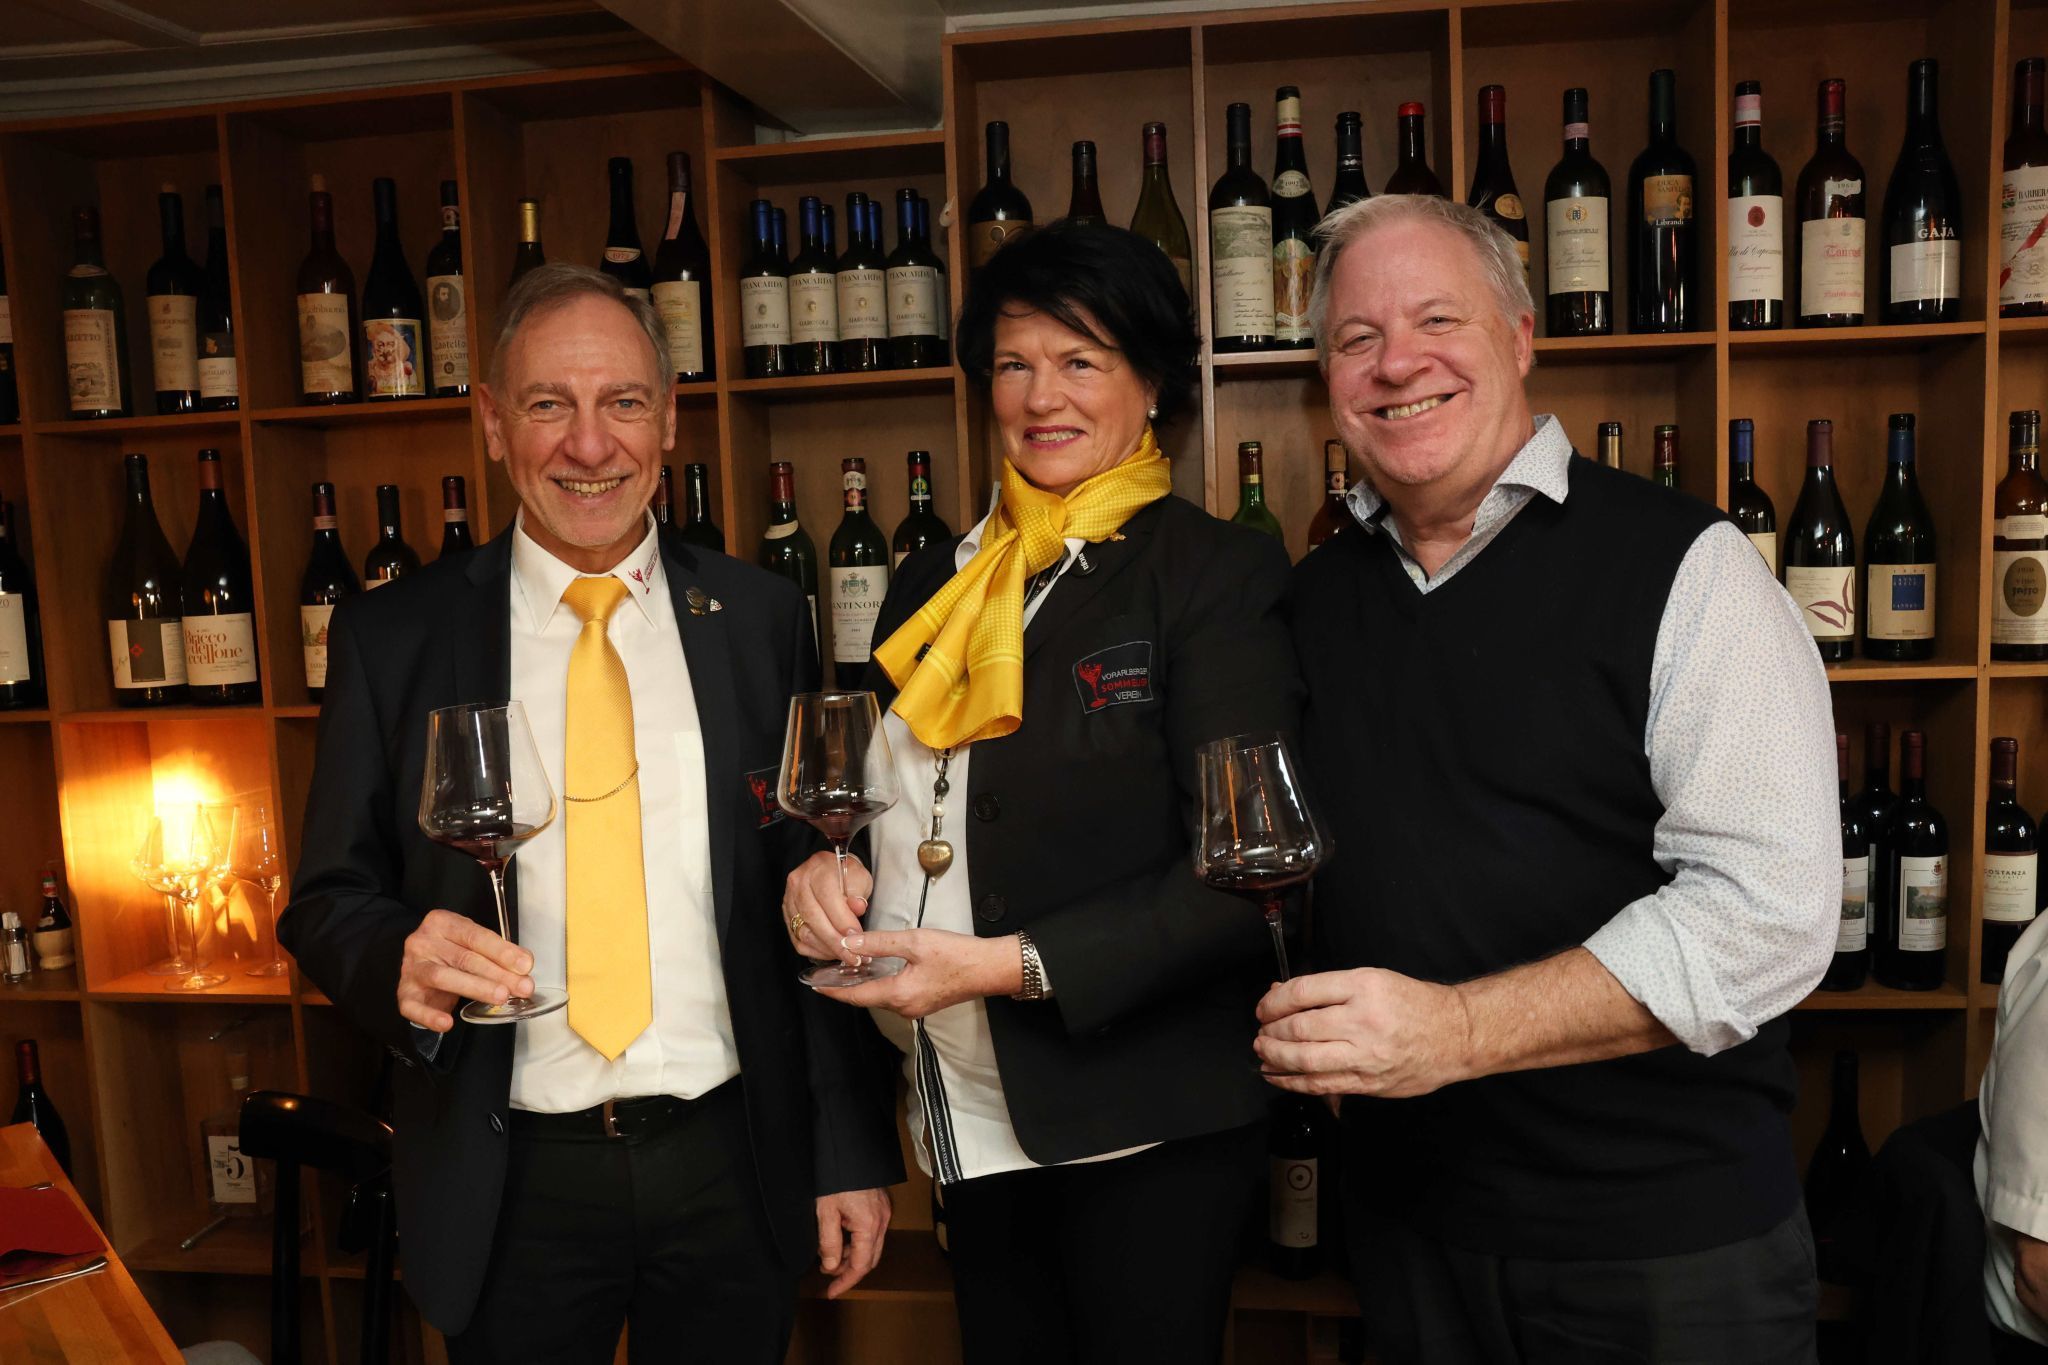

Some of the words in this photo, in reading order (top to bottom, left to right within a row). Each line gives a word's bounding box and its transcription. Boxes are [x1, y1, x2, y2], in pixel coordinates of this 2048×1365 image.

[1656, 218, 1684, 226] Librandi
[1918, 226, 1955, 239] GAJA
[226, 1144, 245, 1180] 5
